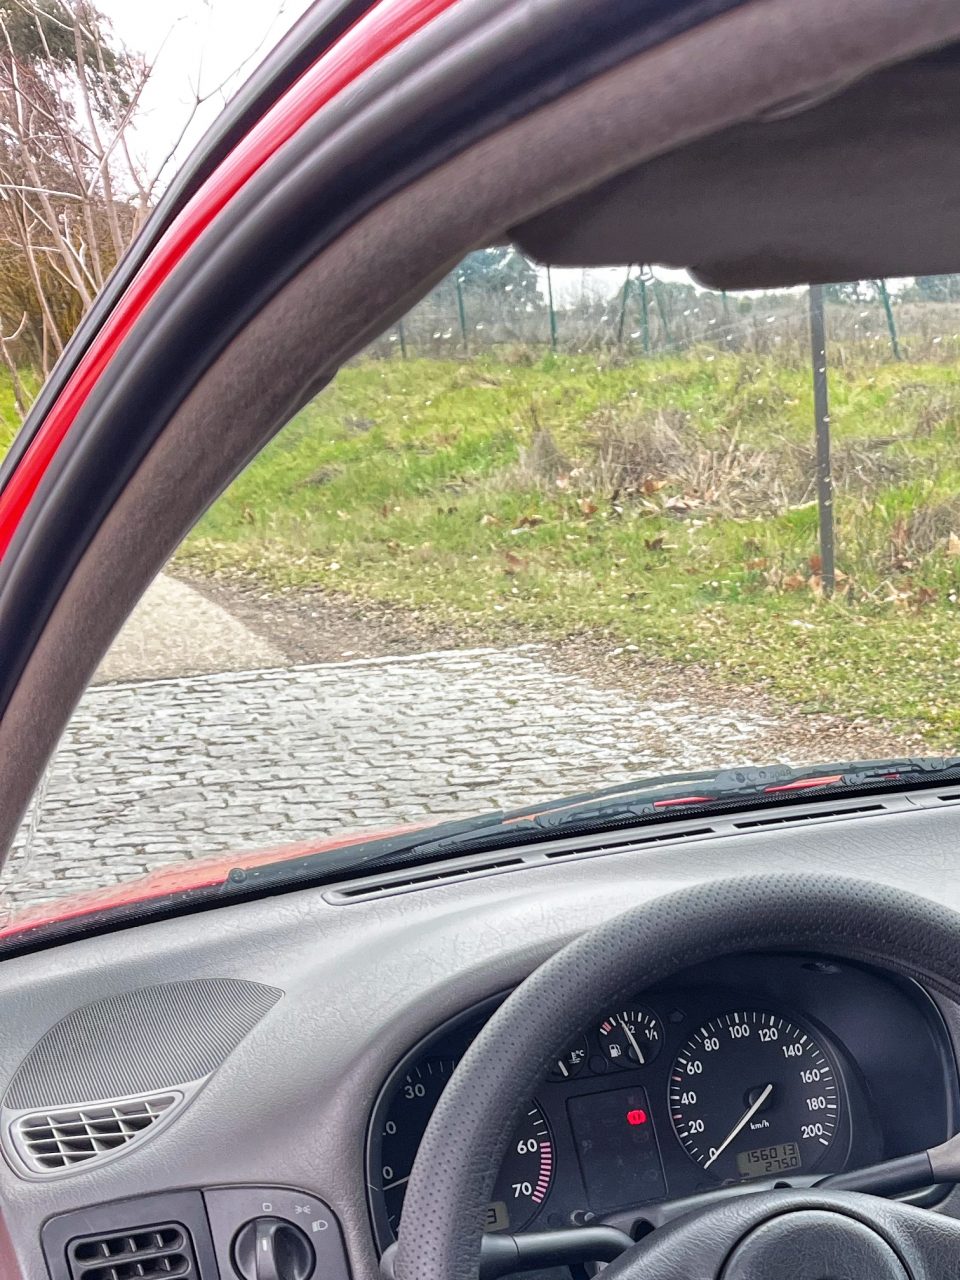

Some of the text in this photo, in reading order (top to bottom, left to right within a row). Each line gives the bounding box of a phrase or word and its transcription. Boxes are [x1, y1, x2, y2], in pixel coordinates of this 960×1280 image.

[729, 1024, 750, 1039] 100
[758, 1027, 778, 1042] 120
[704, 1037, 720, 1051] 80
[782, 1043, 803, 1058] 140
[686, 1061, 703, 1075] 60
[800, 1068, 820, 1083] 160
[404, 1083, 426, 1099] 30
[681, 1091, 697, 1105] 40
[806, 1096, 826, 1111] 180
[688, 1119, 705, 1134] 20
[750, 1119, 770, 1130] km/h
[801, 1123, 823, 1139] 200
[516, 1138, 538, 1154] 60
[747, 1143, 796, 1163] 156013
[512, 1181, 533, 1198] 70
